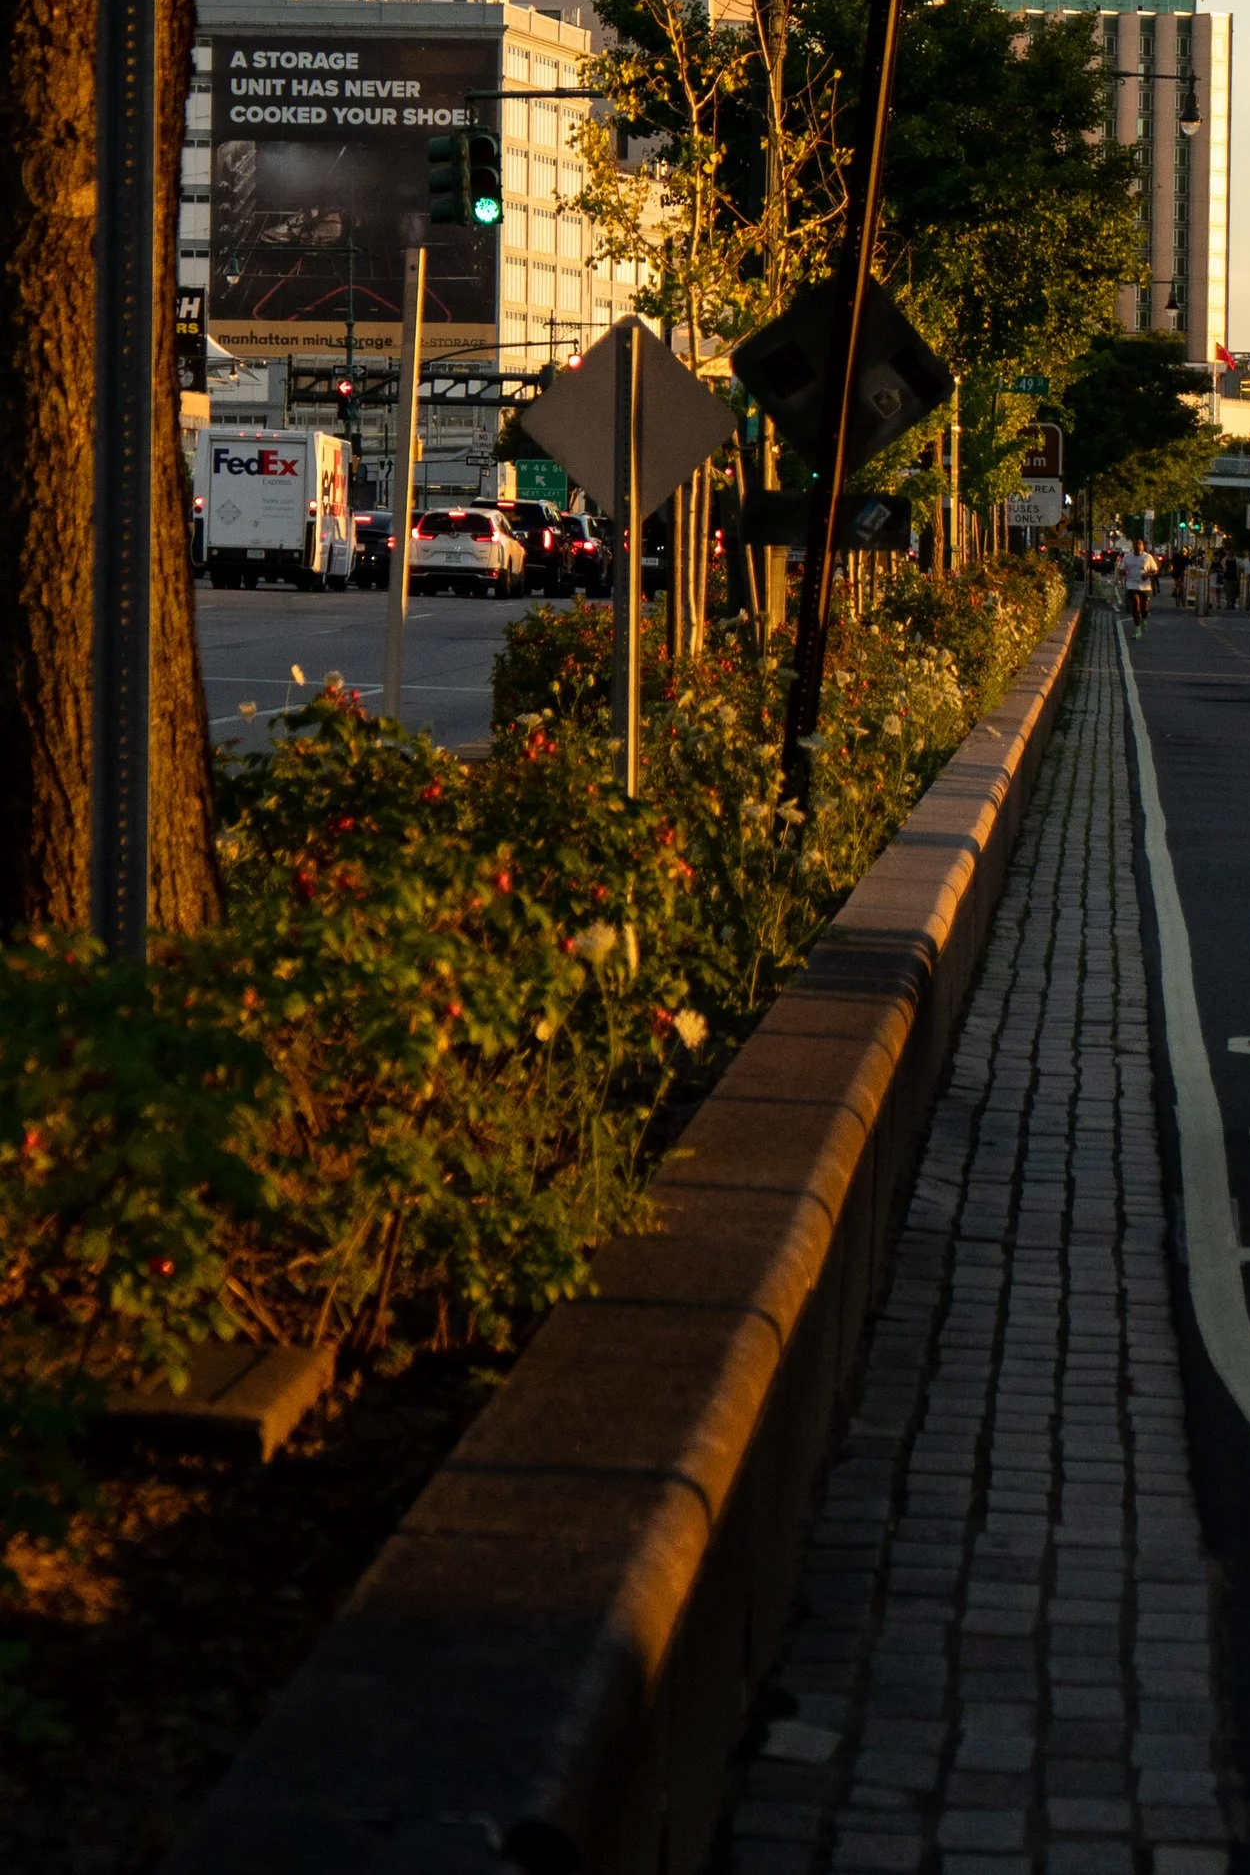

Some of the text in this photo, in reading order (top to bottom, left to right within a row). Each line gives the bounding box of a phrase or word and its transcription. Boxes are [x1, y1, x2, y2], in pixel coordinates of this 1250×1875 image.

[230, 51, 359, 70] A STORAGE
[230, 78, 421, 99] UNIT HAS NEVER
[229, 106, 327, 125] COOKED
[332, 107, 397, 126] YOUR
[176, 296, 202, 319] H
[218, 330, 299, 346] manhattan
[302, 334, 333, 347] mini
[1019, 377, 1034, 392] 49
[213, 448, 299, 477] FedEx
[520, 464, 528, 472] W
[533, 464, 548, 473] 46
[262, 478, 292, 486] Express
[1034, 485, 1056, 494] REA
[1014, 514, 1044, 524] ONLY
